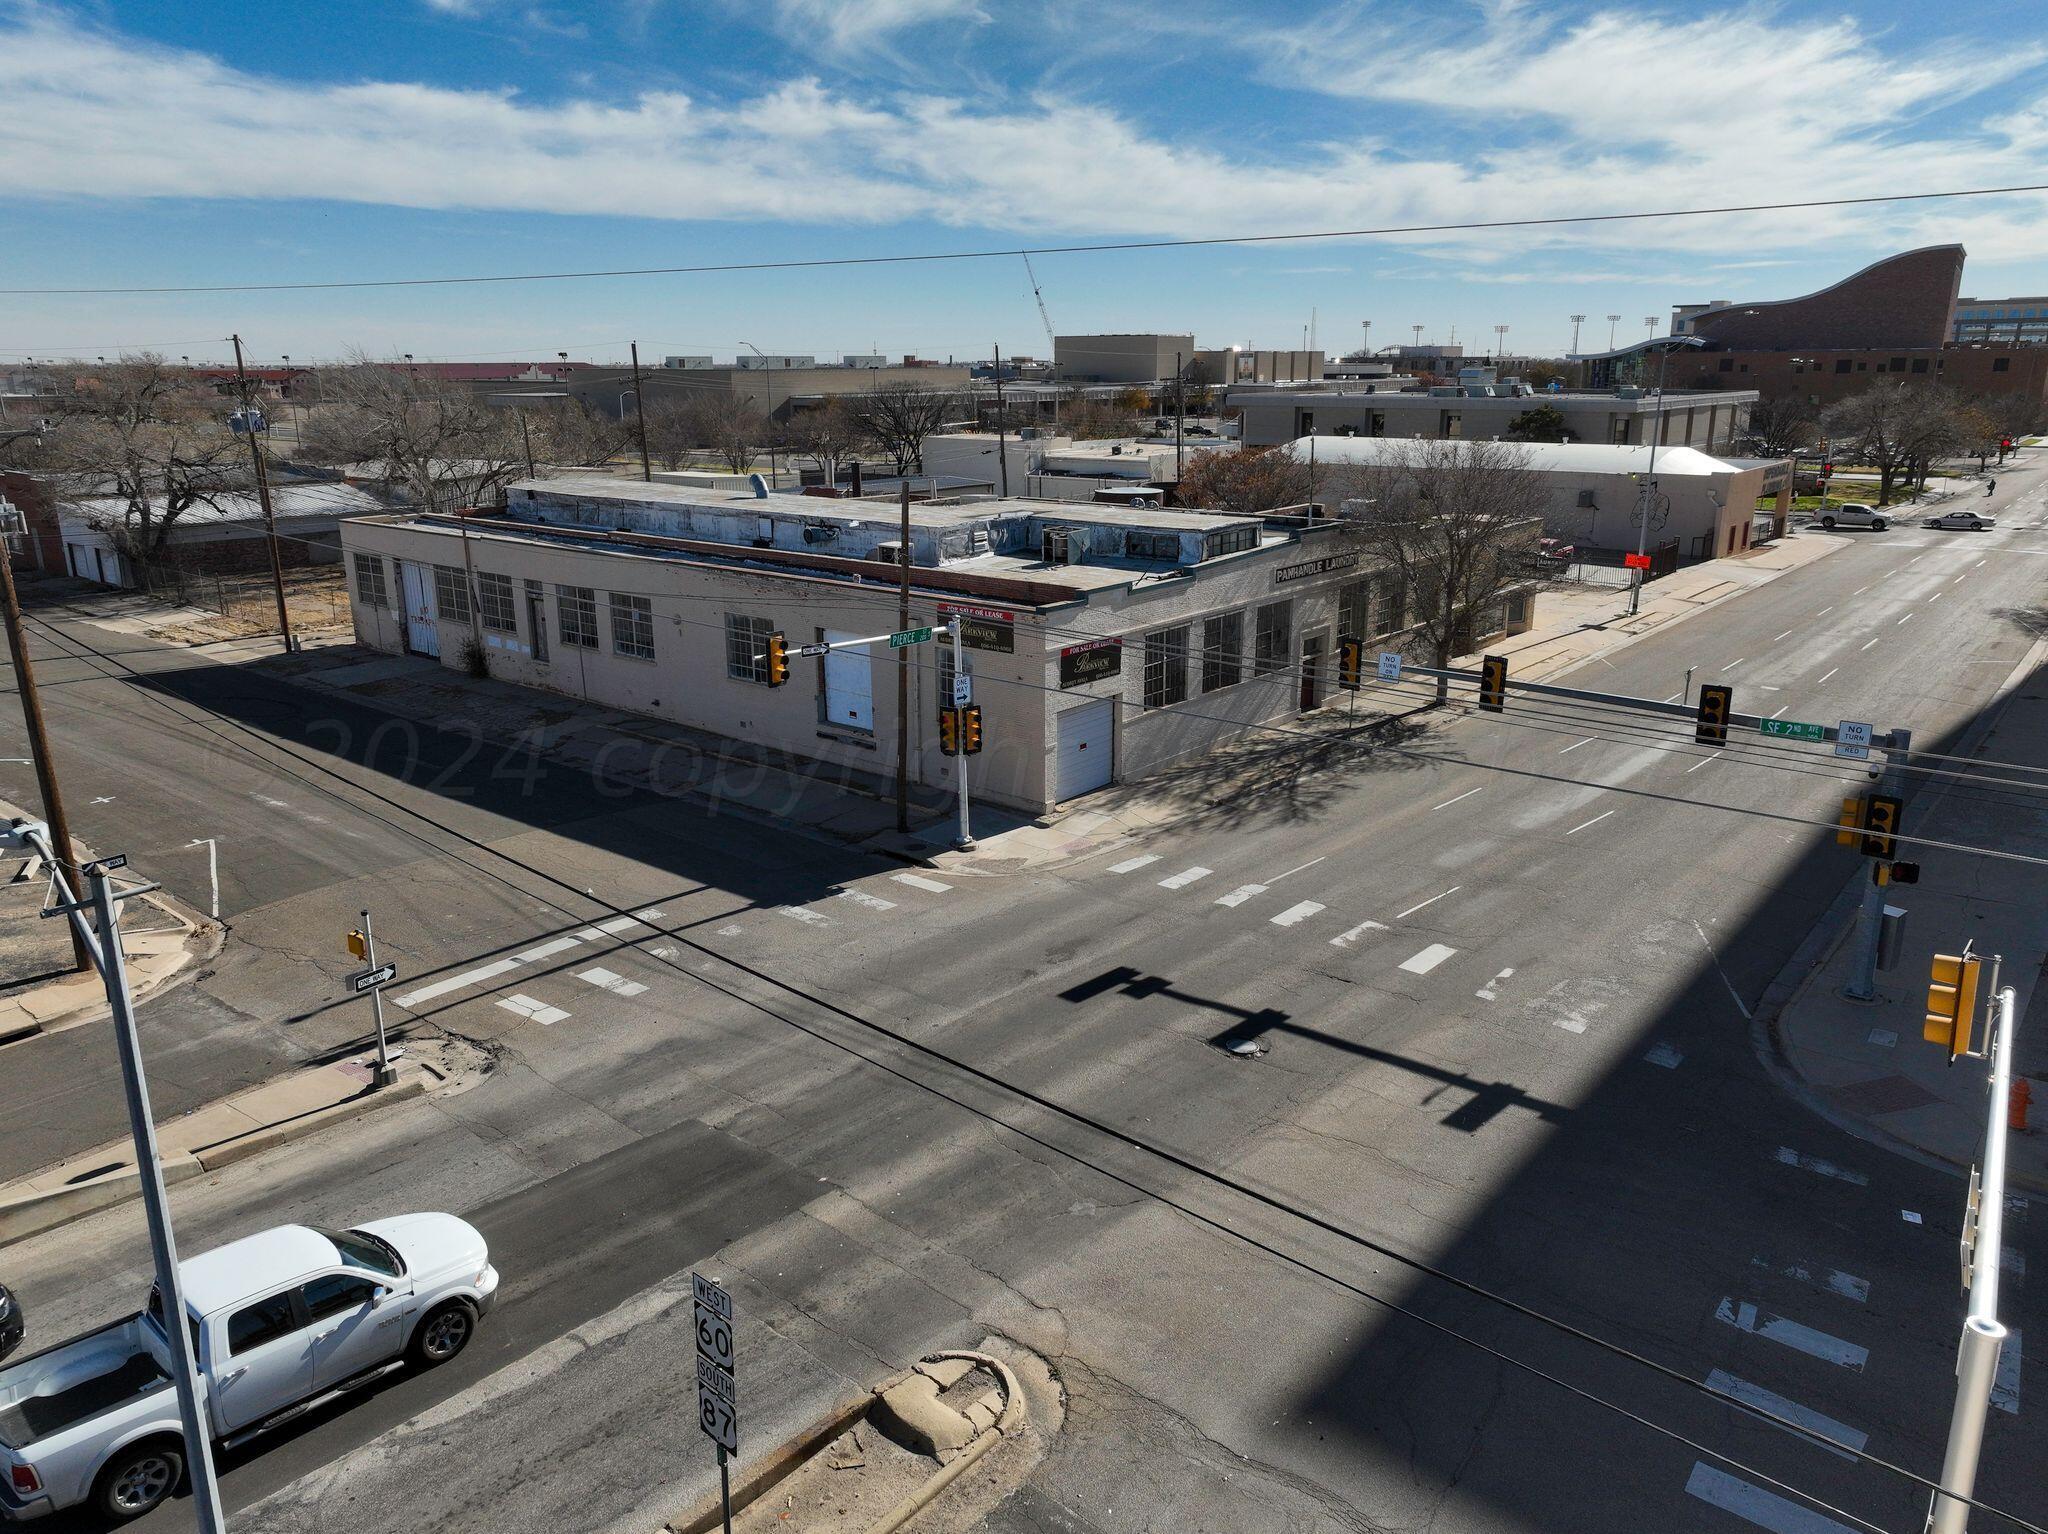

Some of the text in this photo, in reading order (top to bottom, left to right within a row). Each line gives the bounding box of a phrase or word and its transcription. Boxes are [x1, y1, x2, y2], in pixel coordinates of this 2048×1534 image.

[1276, 561, 1323, 582] PANHANDLE
[985, 611, 1003, 619] LEASE
[892, 632, 916, 646] PIERCE
[1070, 646, 1080, 654] FOR
[1080, 643, 1092, 653] SALE
[1092, 641, 1100, 649] OR
[957, 678, 968, 686] ONE
[1808, 725, 1820, 733] AVE
[1848, 726, 1862, 734] NO
[1845, 733, 1864, 741] TURN
[1844, 746, 1859, 754] RED
[360, 972, 384, 987] ONE WAY
[698, 1283, 726, 1311] WEST
[700, 1318, 729, 1358] 60
[700, 1362, 732, 1397] SOUTH
[703, 1399, 732, 1438] 87
